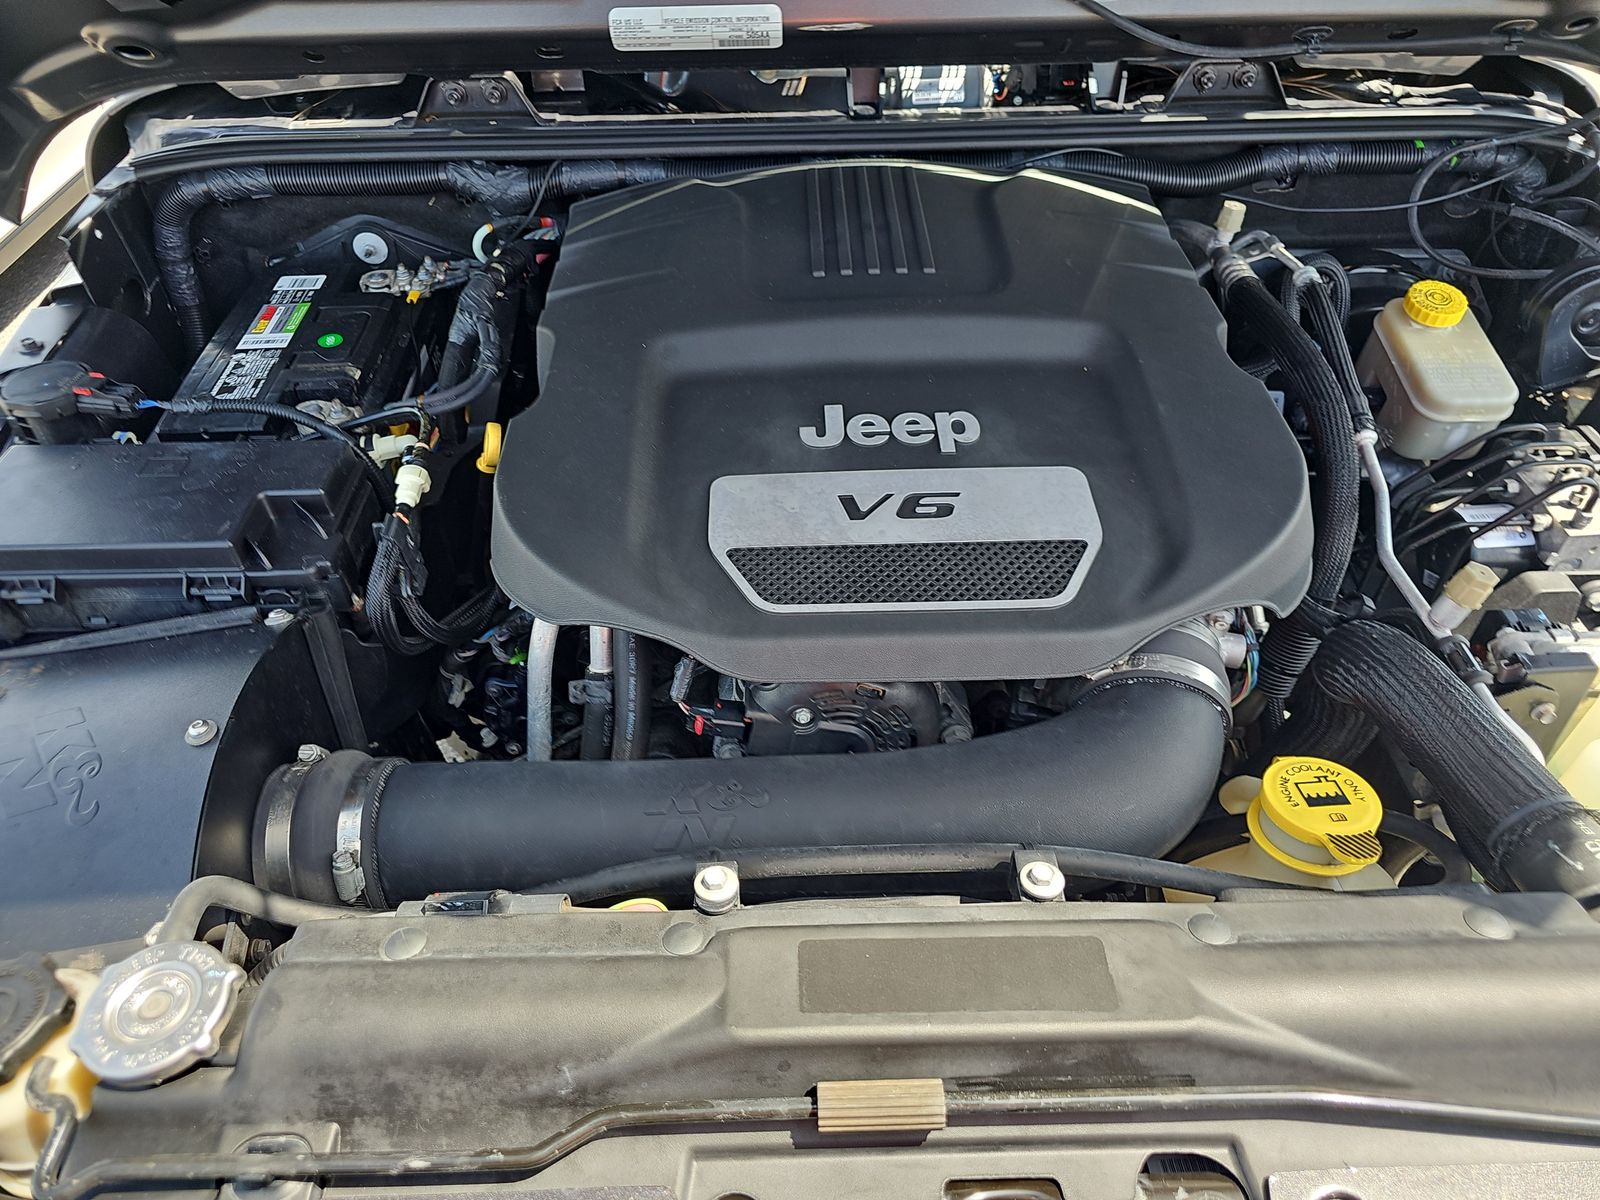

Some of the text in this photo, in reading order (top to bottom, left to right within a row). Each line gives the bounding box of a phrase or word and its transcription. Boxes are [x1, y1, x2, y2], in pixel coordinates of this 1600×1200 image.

[799, 404, 981, 455] Jeep
[837, 492, 961, 521] V6
[1279, 764, 1367, 808] ENGINE COOLANT ONLY
